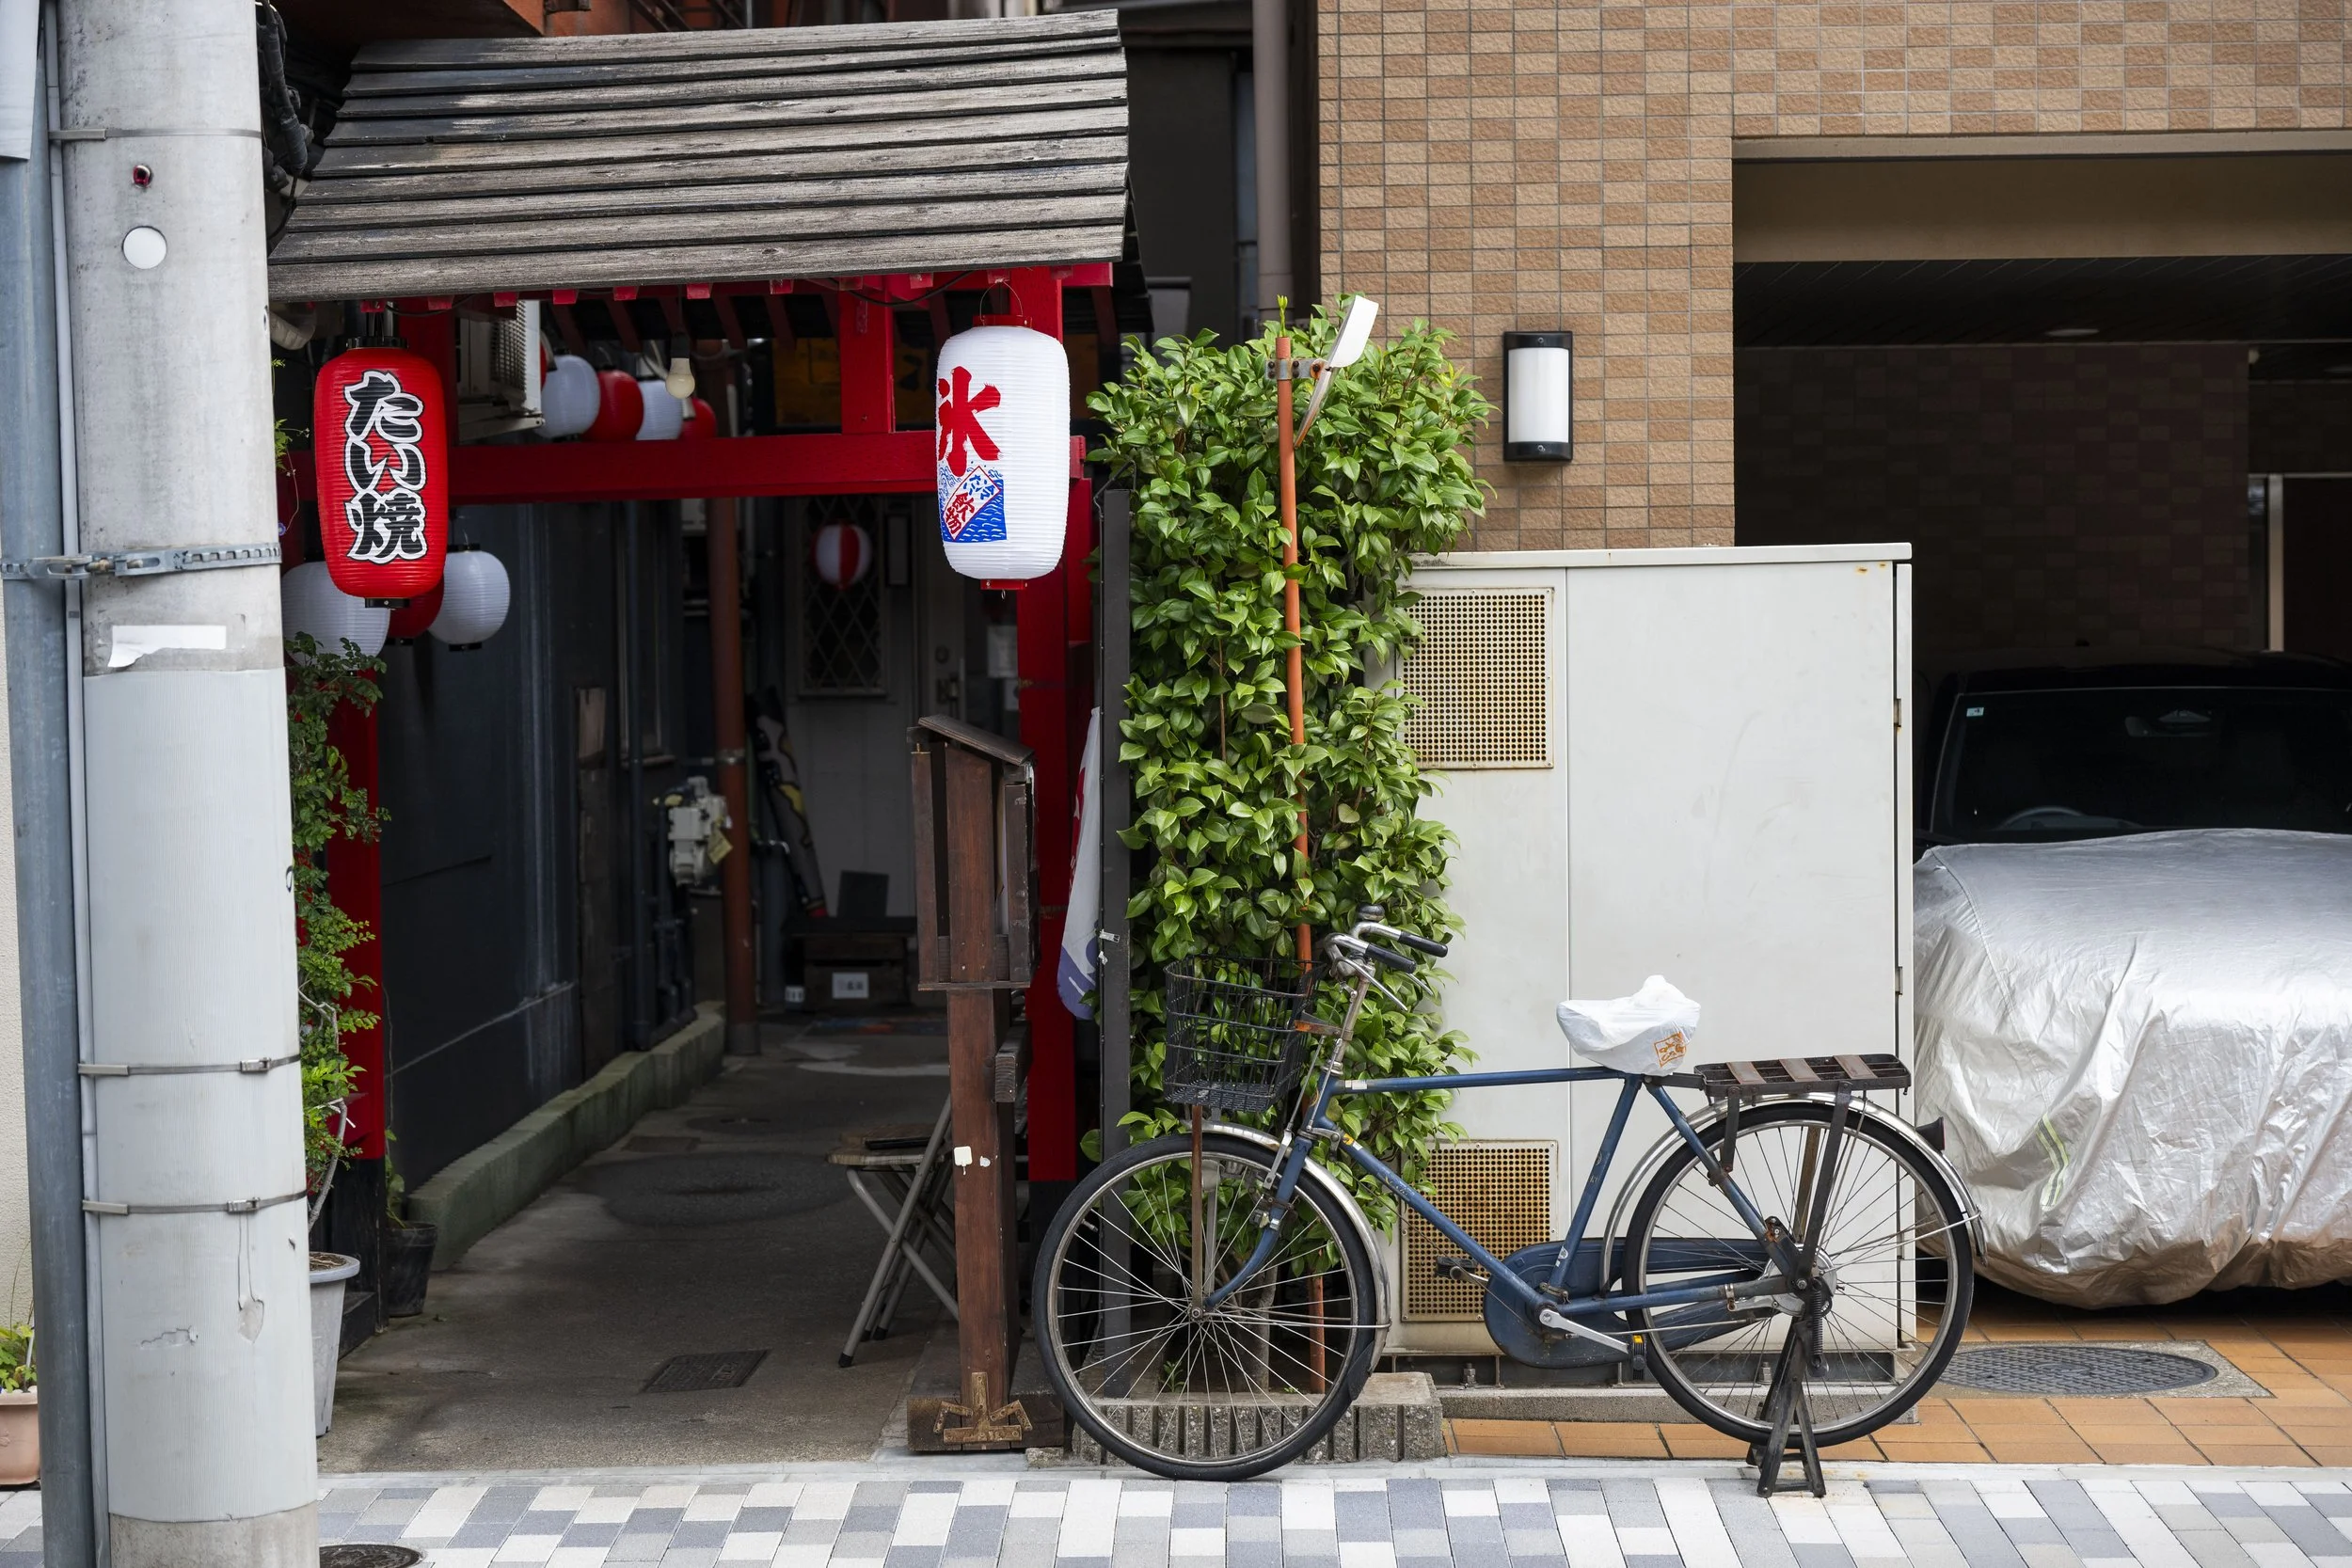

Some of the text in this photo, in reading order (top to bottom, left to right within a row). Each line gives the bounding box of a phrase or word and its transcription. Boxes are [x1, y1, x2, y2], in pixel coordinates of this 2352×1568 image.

[344, 371, 427, 564] たい焼
[939, 366, 1001, 477] 氷
